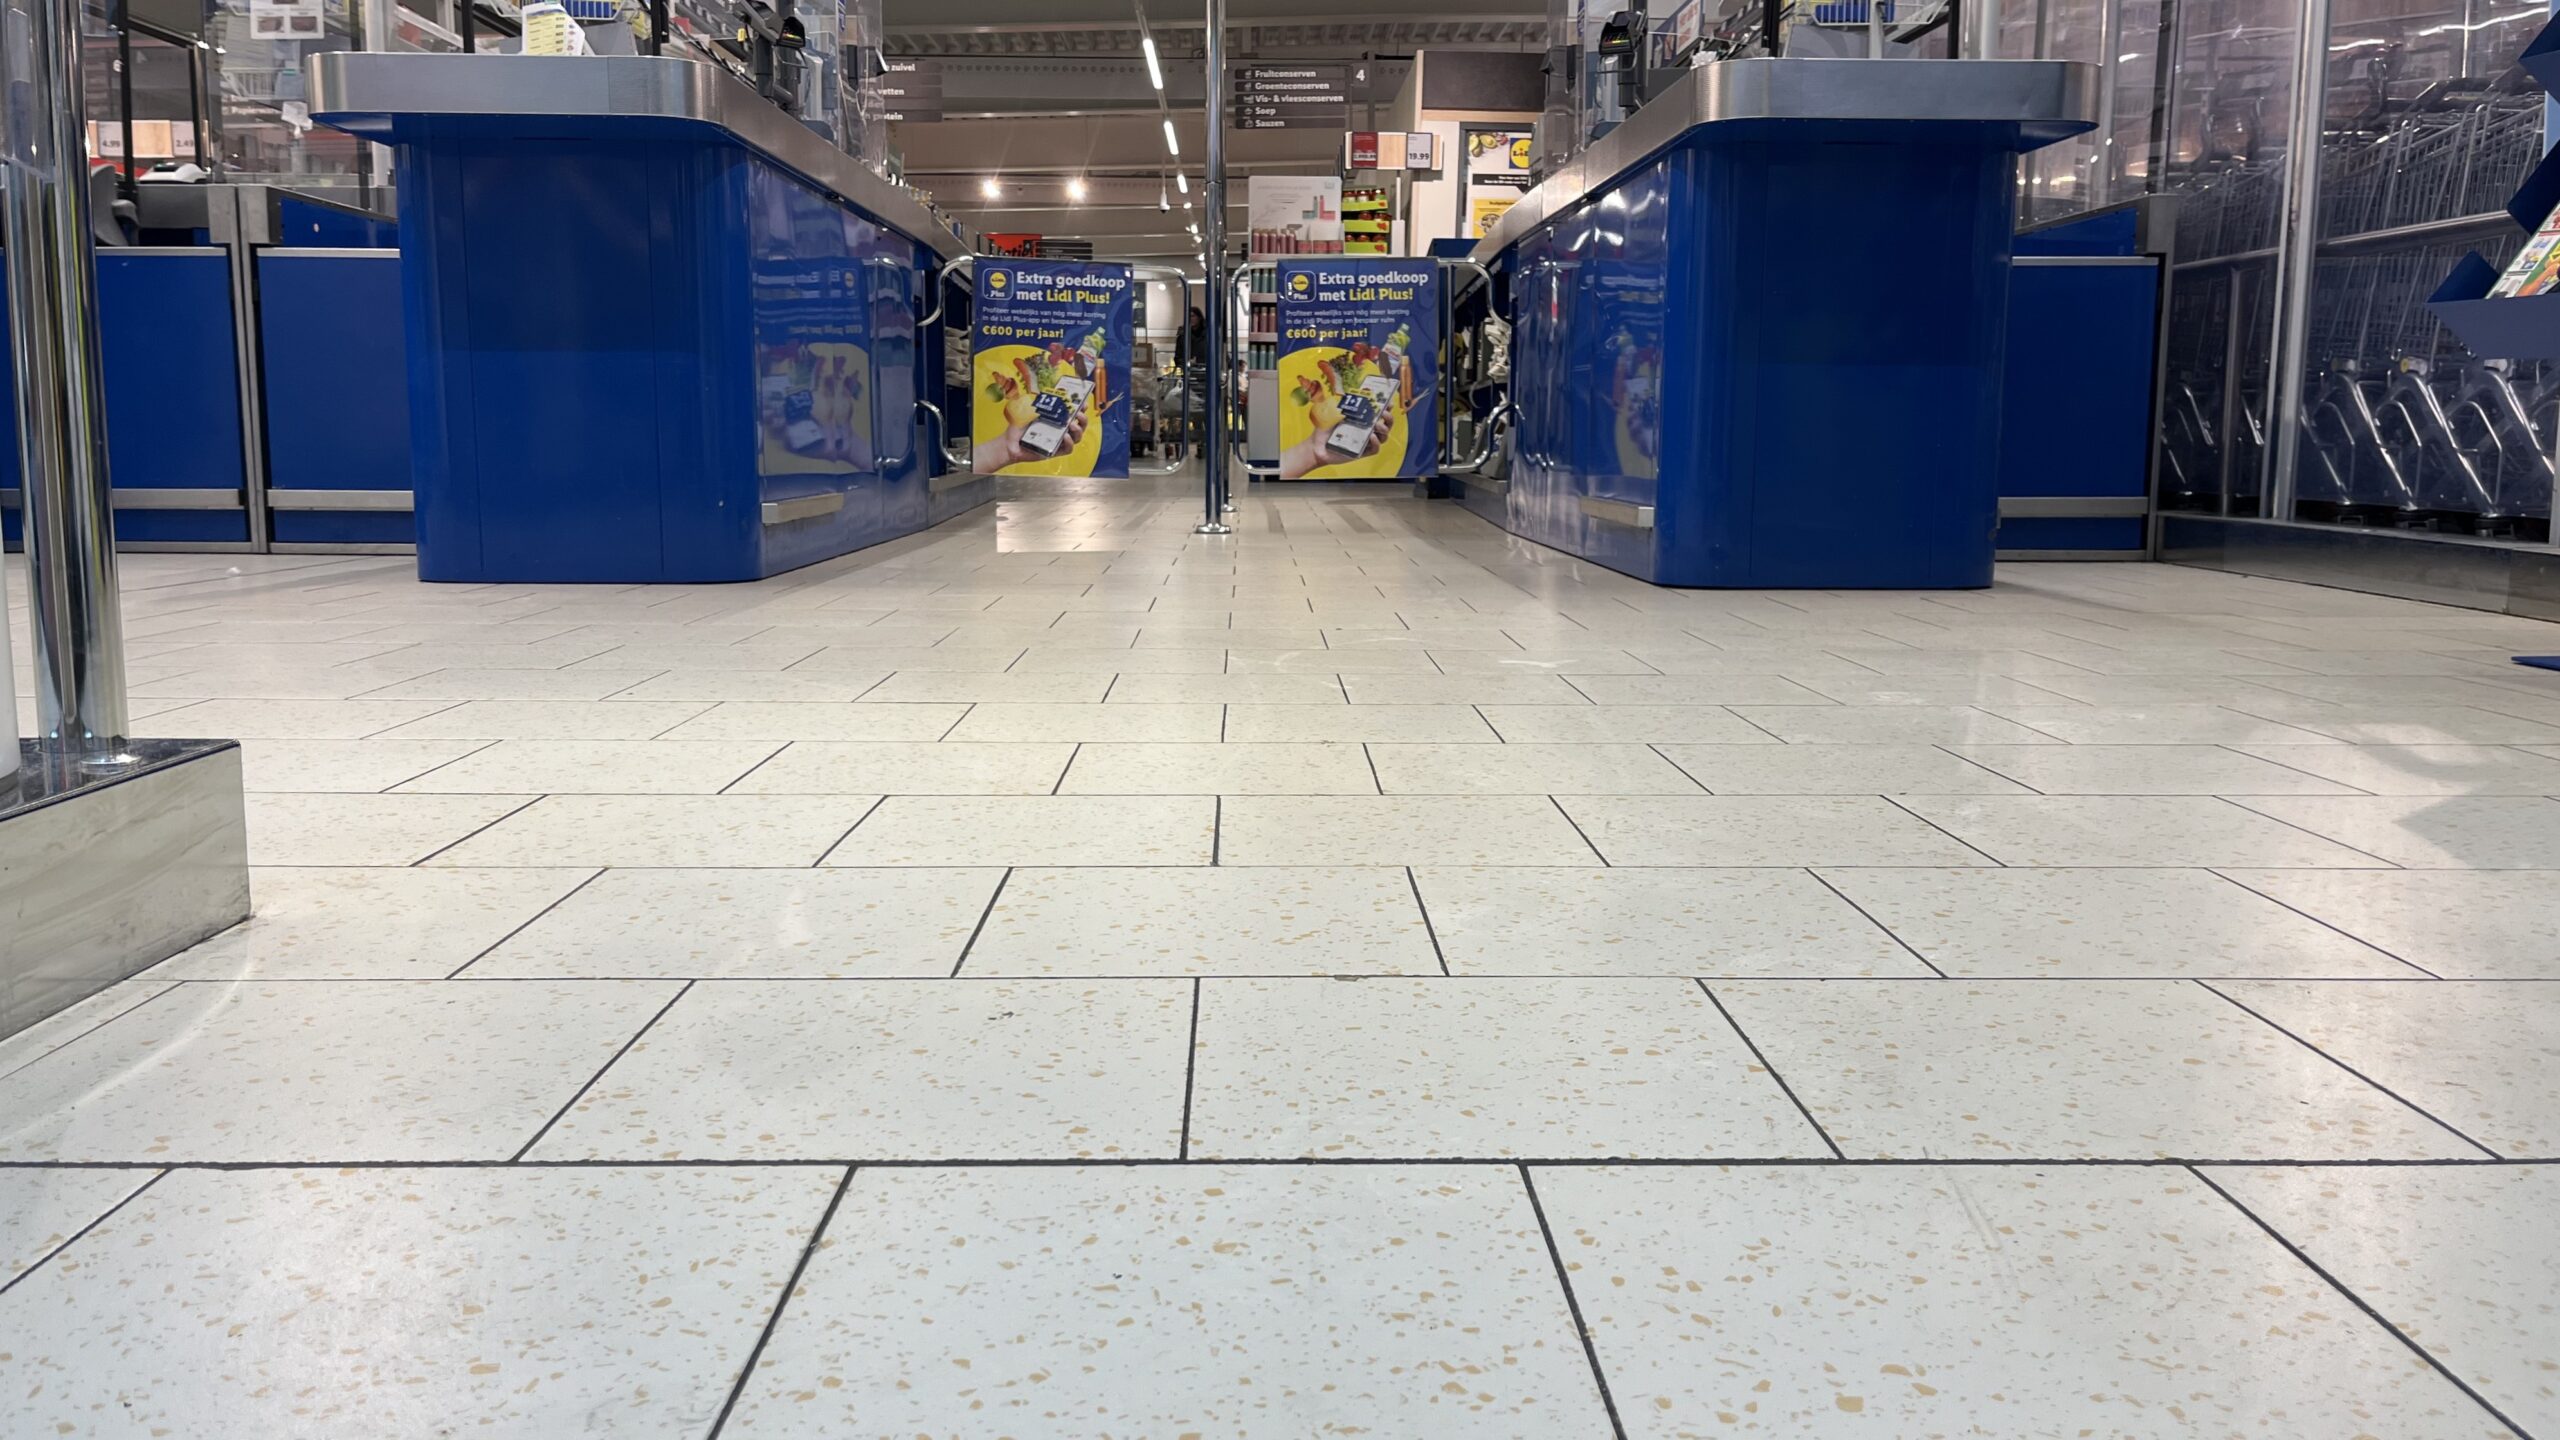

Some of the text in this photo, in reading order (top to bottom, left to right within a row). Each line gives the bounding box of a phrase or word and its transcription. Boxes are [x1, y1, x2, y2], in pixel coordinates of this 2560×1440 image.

[891, 63, 916, 72] zuivel
[1255, 70, 1317, 78] Fruitconserven
[1355, 69, 1366, 81] 4
[877, 87, 905, 96] vetten
[1255, 82, 1330, 90] Groenteconserven
[1255, 94, 1344, 103] Vis- & vleesconserven
[1255, 106, 1276, 116] Soep
[1255, 119, 1285, 128] Sauzen
[1016, 271, 1126, 291] Extra goedkoop
[1318, 271, 1428, 287] Extra goedkoop
[1016, 289, 1110, 304] met Lidl Plus!
[1318, 288, 1413, 301] met Lidl Plus!
[1011, 308, 1038, 317] wekelijks
[1084, 311, 1106, 320] korting
[1314, 310, 1342, 318] wekelijks
[1387, 308, 1410, 316] korting
[1013, 316, 1041, 324] Plus-app
[1051, 318, 1076, 326] bespaar
[1316, 317, 1344, 325] Plus-app
[1354, 317, 1379, 325] bespaar
[982, 325, 1063, 339] €600 per jaar!
[1286, 328, 1368, 341] €600 per jaar!
[1039, 394, 1058, 407] 1+1
[1345, 395, 1363, 407] 1+1
